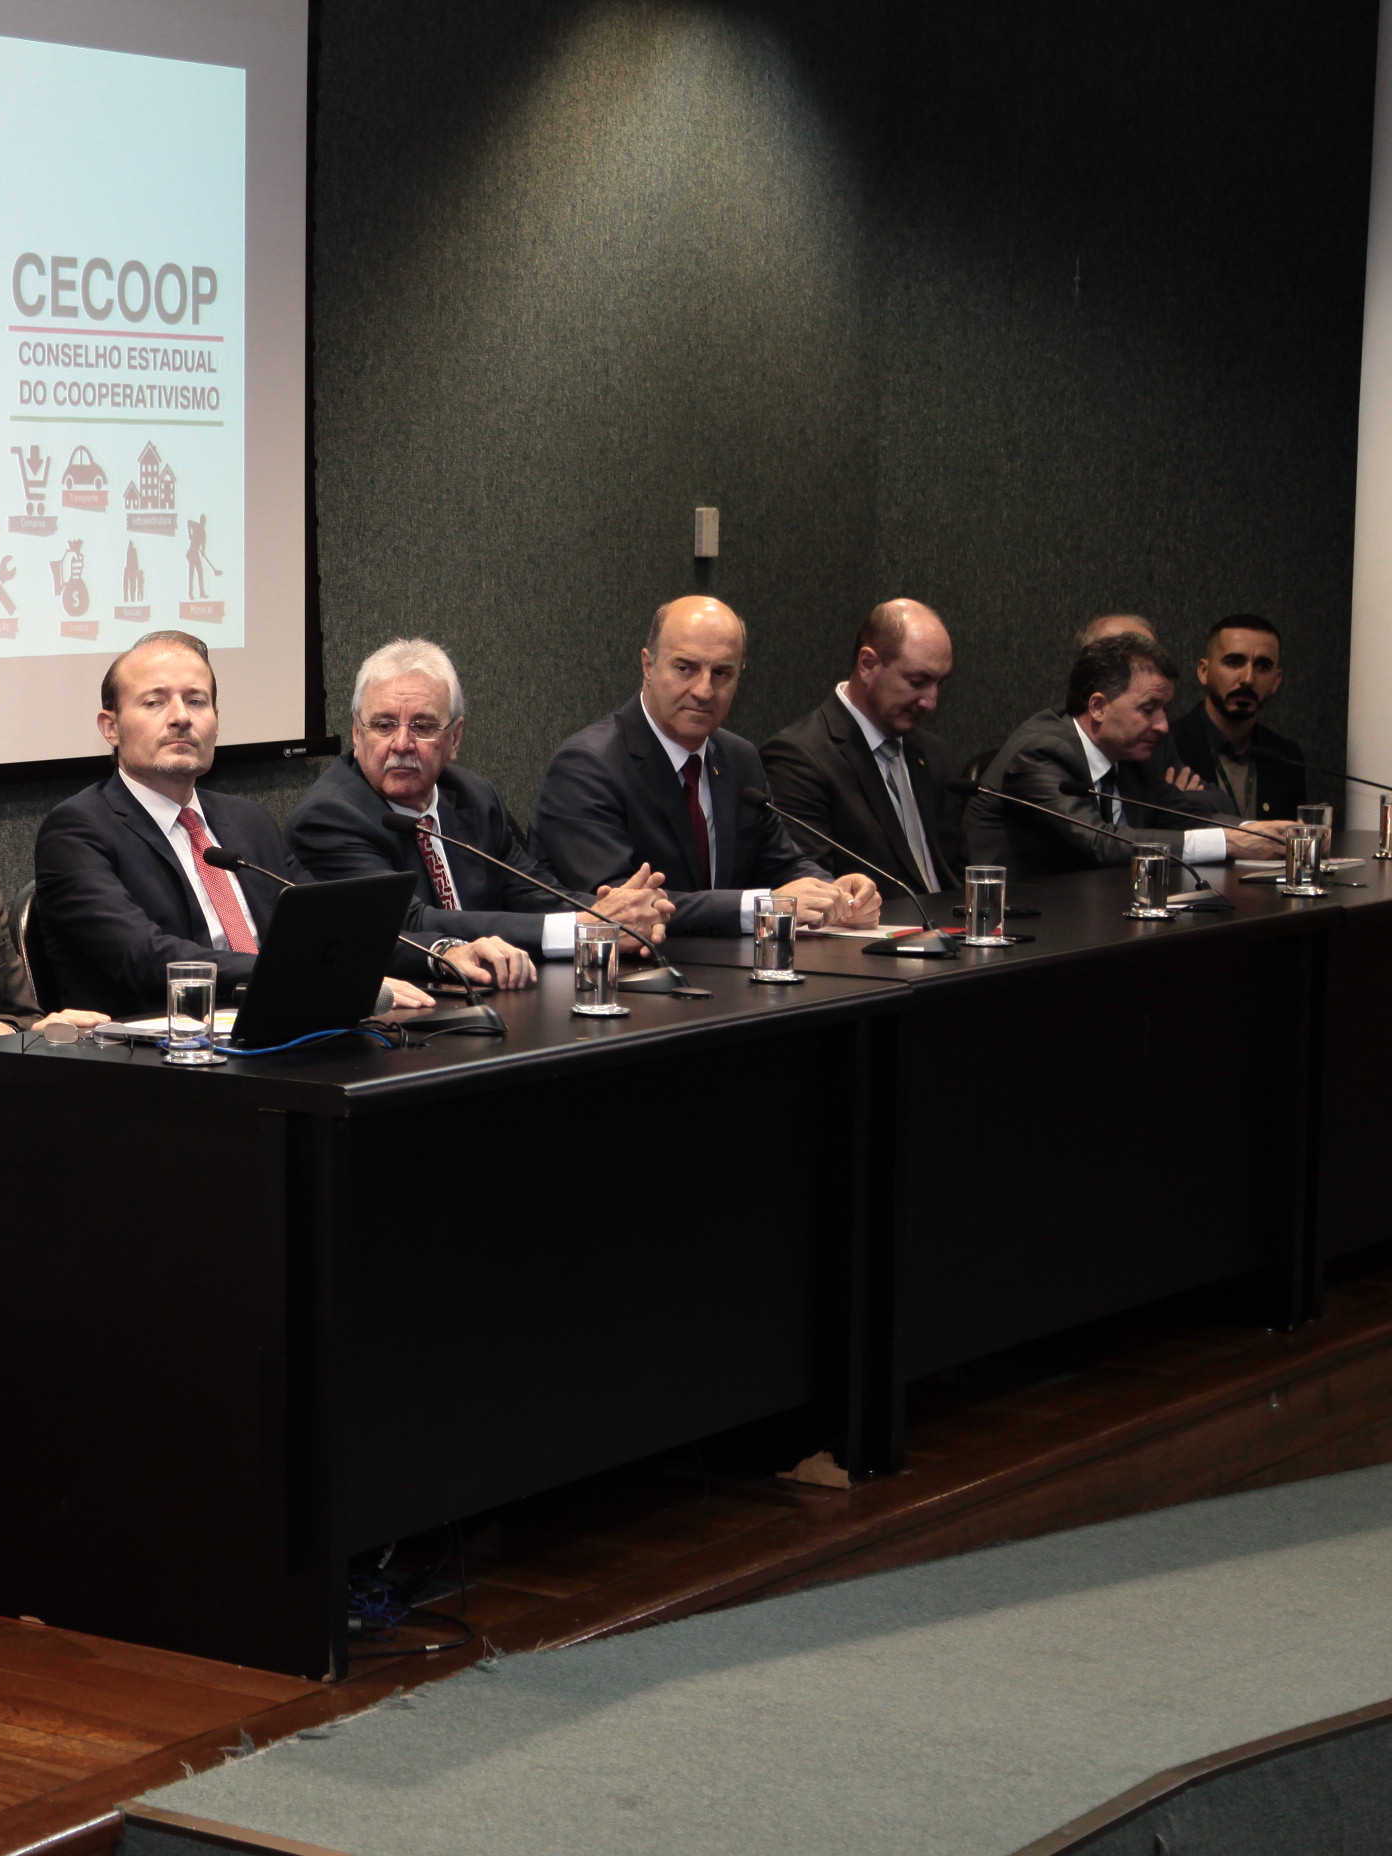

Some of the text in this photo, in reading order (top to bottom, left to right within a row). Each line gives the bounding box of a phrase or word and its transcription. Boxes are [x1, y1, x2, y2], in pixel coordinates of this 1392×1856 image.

[12, 252, 218, 325] CECOOP
[18, 341, 217, 373] CONSELHO ESTADUAL
[19, 380, 220, 411] DO COOPERATIVISMO
